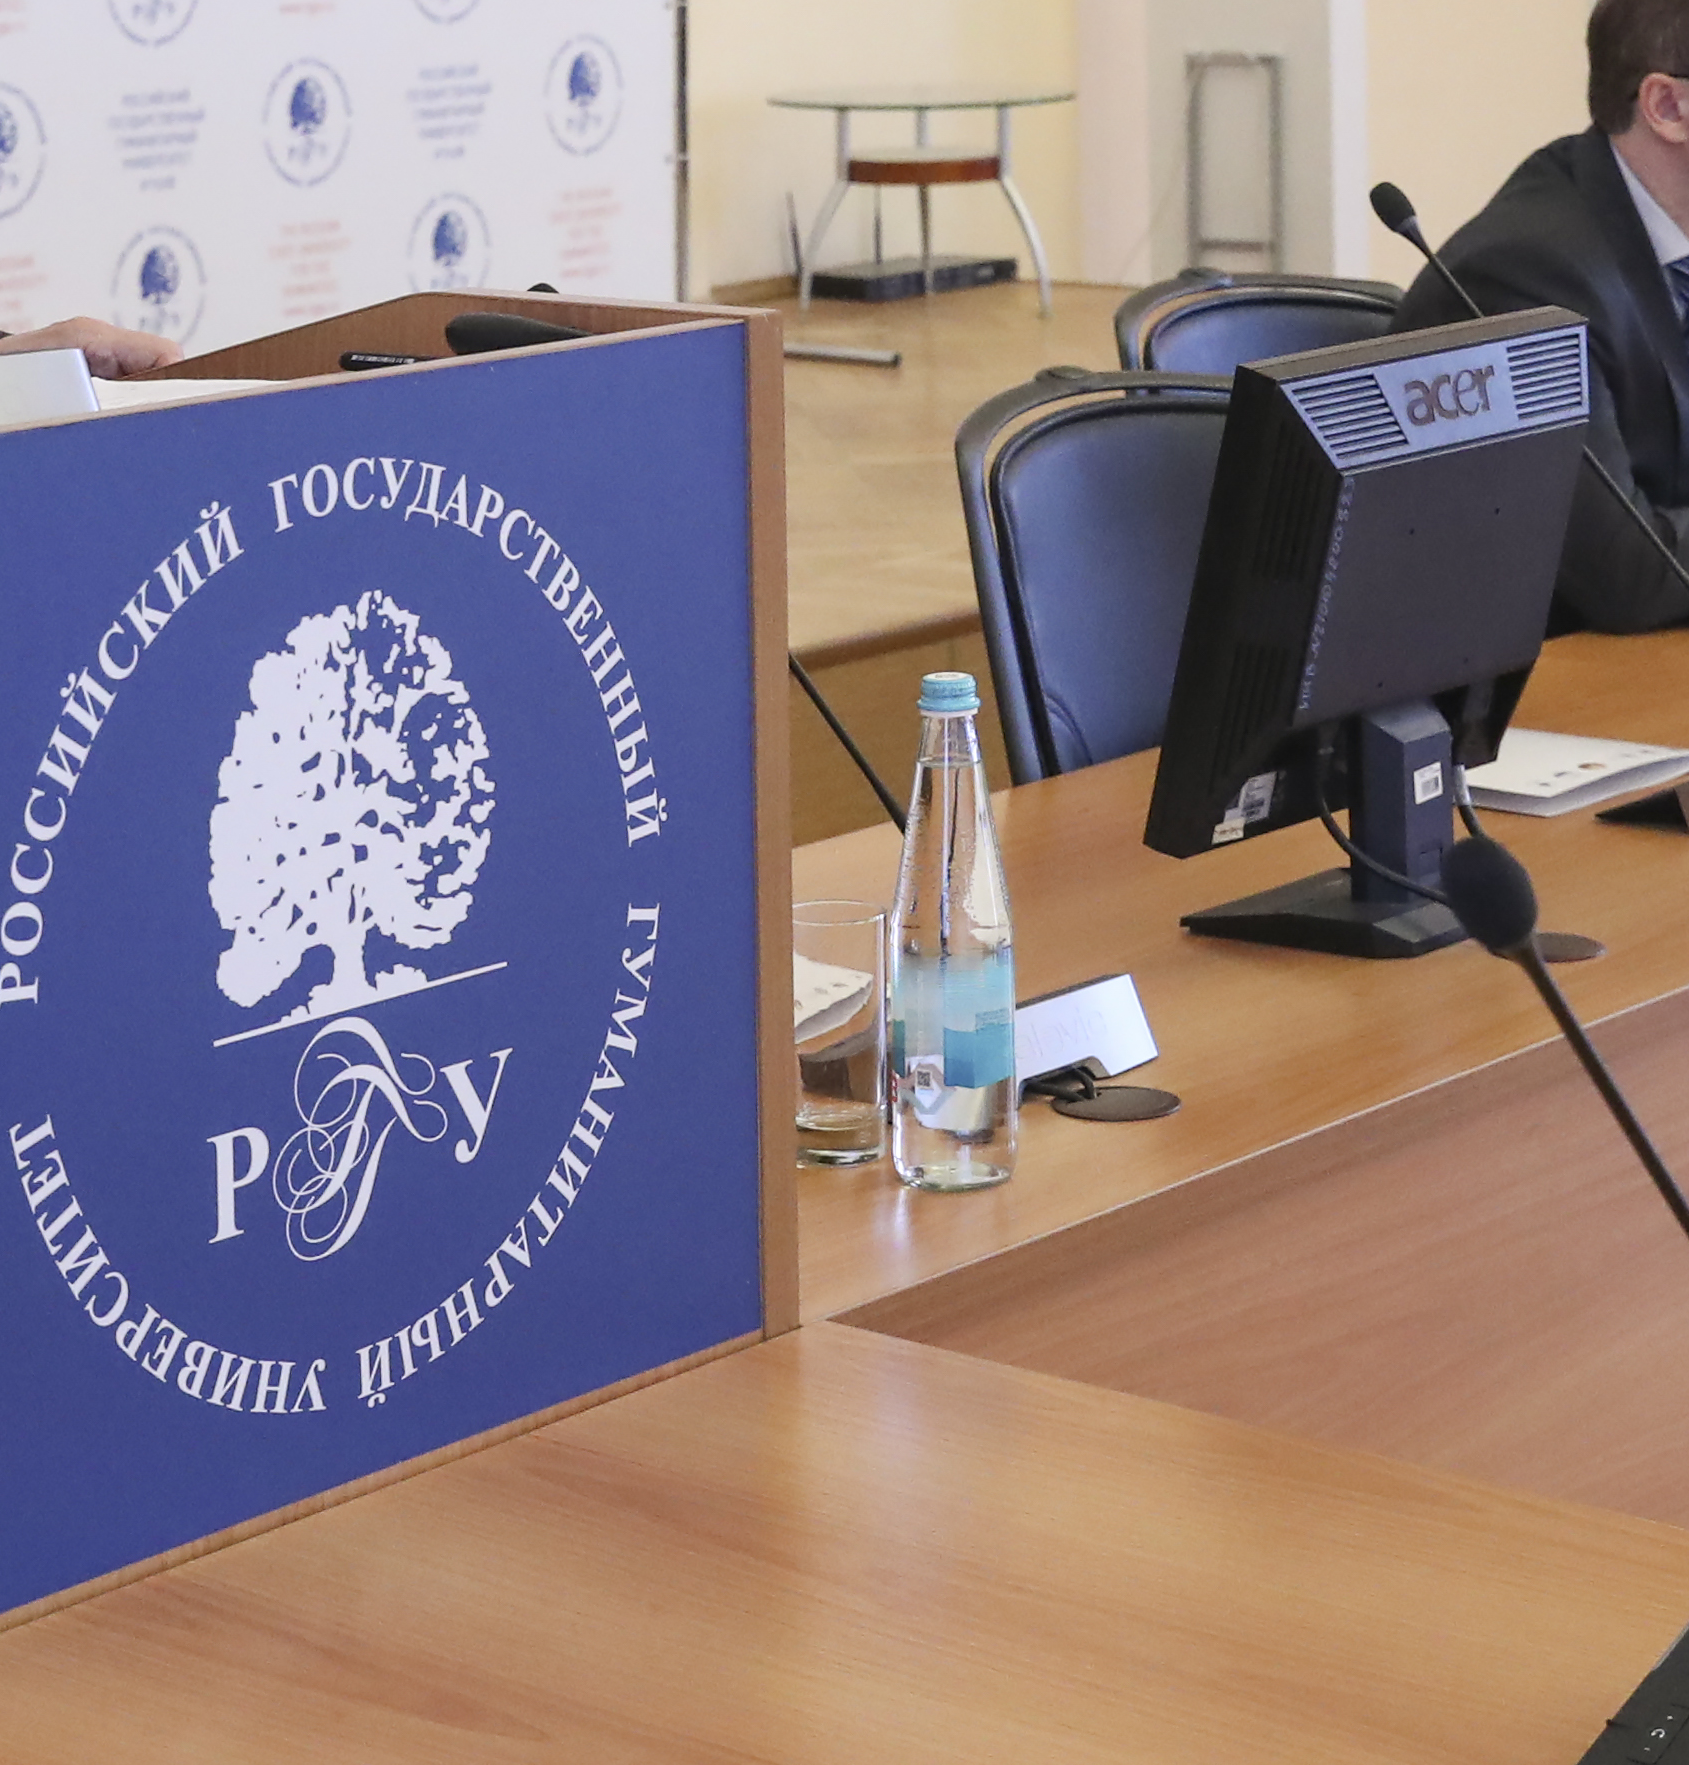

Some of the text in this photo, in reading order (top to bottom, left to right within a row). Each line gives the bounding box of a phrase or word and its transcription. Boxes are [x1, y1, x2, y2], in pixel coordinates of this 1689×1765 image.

[1404, 364, 1495, 427] acer
[268, 456, 669, 848] ГОСУДАРСТВЕННЫЙ
[8, 1113, 327, 1415] УНИВЕРСИТЕТ
[355, 902, 660, 1409] ГУМАНИТАРНЫЙ
